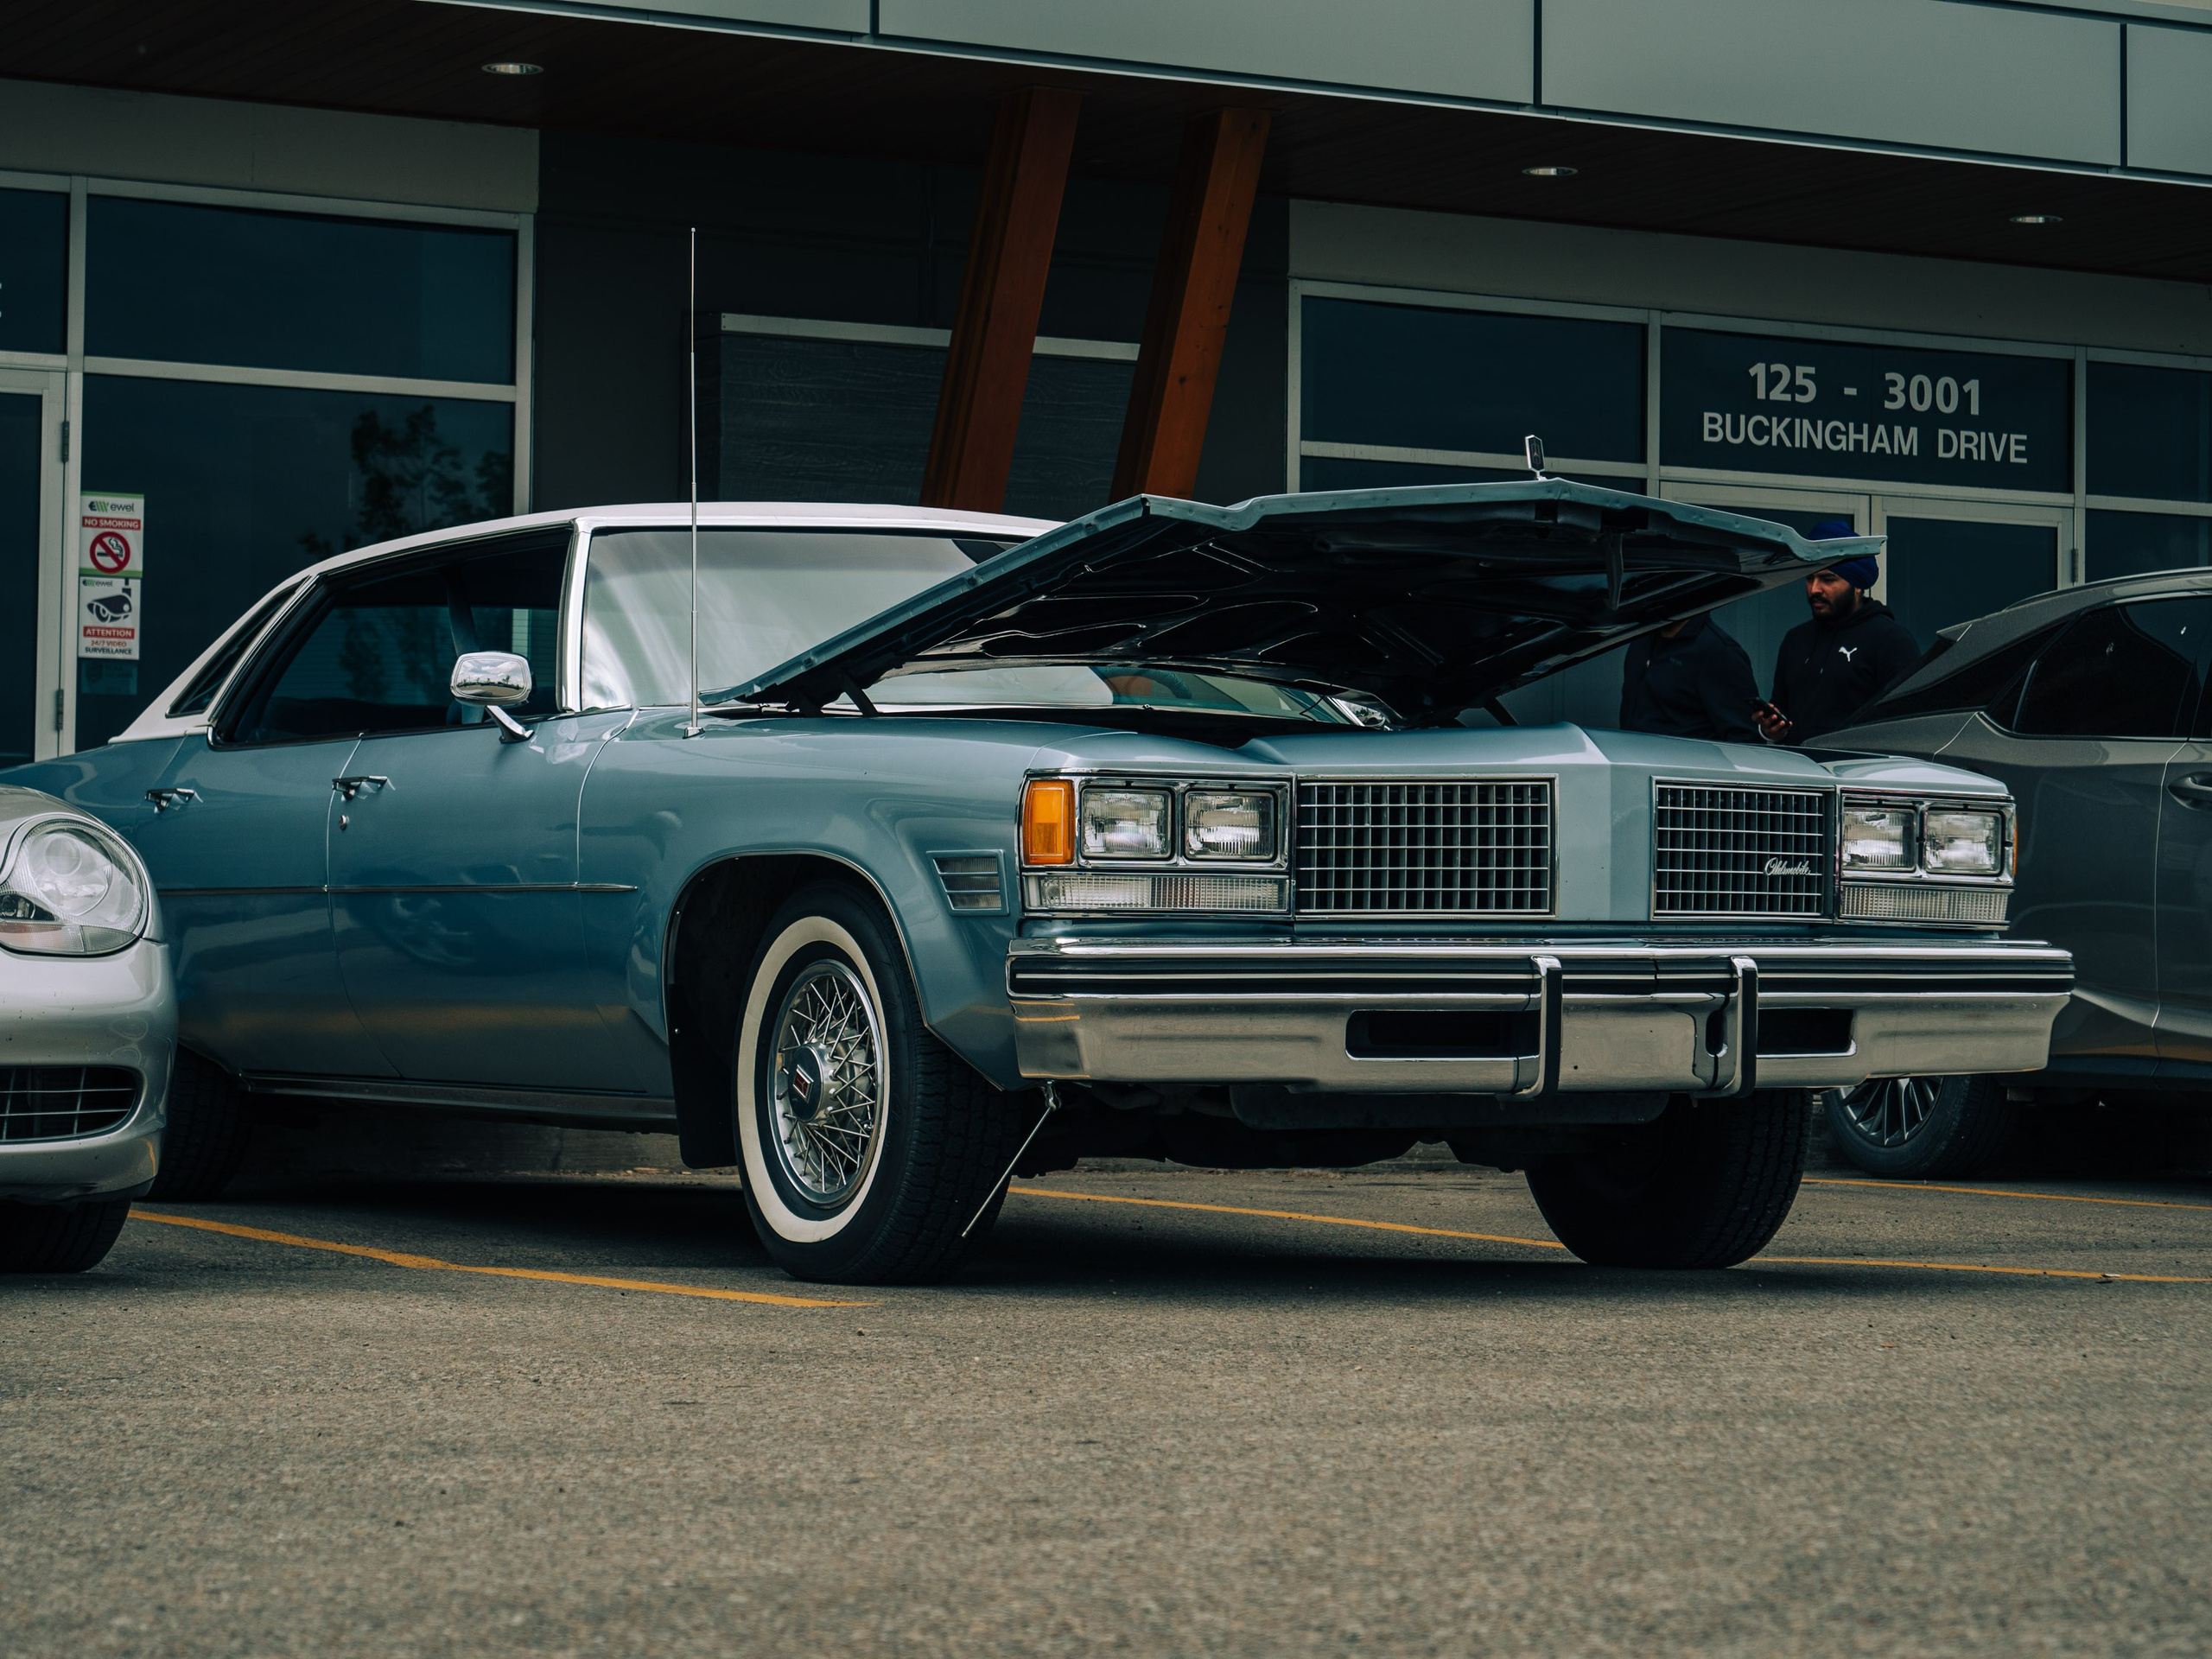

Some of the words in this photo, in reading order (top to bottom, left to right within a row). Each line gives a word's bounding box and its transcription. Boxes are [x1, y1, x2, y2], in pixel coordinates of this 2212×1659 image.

[1748, 362, 1817, 404] 125
[1843, 387, 1858, 396] -
[1884, 372, 1980, 416] 3001
[1703, 411, 1918, 457] BUCKINGHAM
[1937, 429, 2028, 464] DRIVE
[99, 519, 138, 529] SMOKING
[86, 628, 132, 638] ATTENTION
[85, 646, 132, 655] SURVEILLANCE
